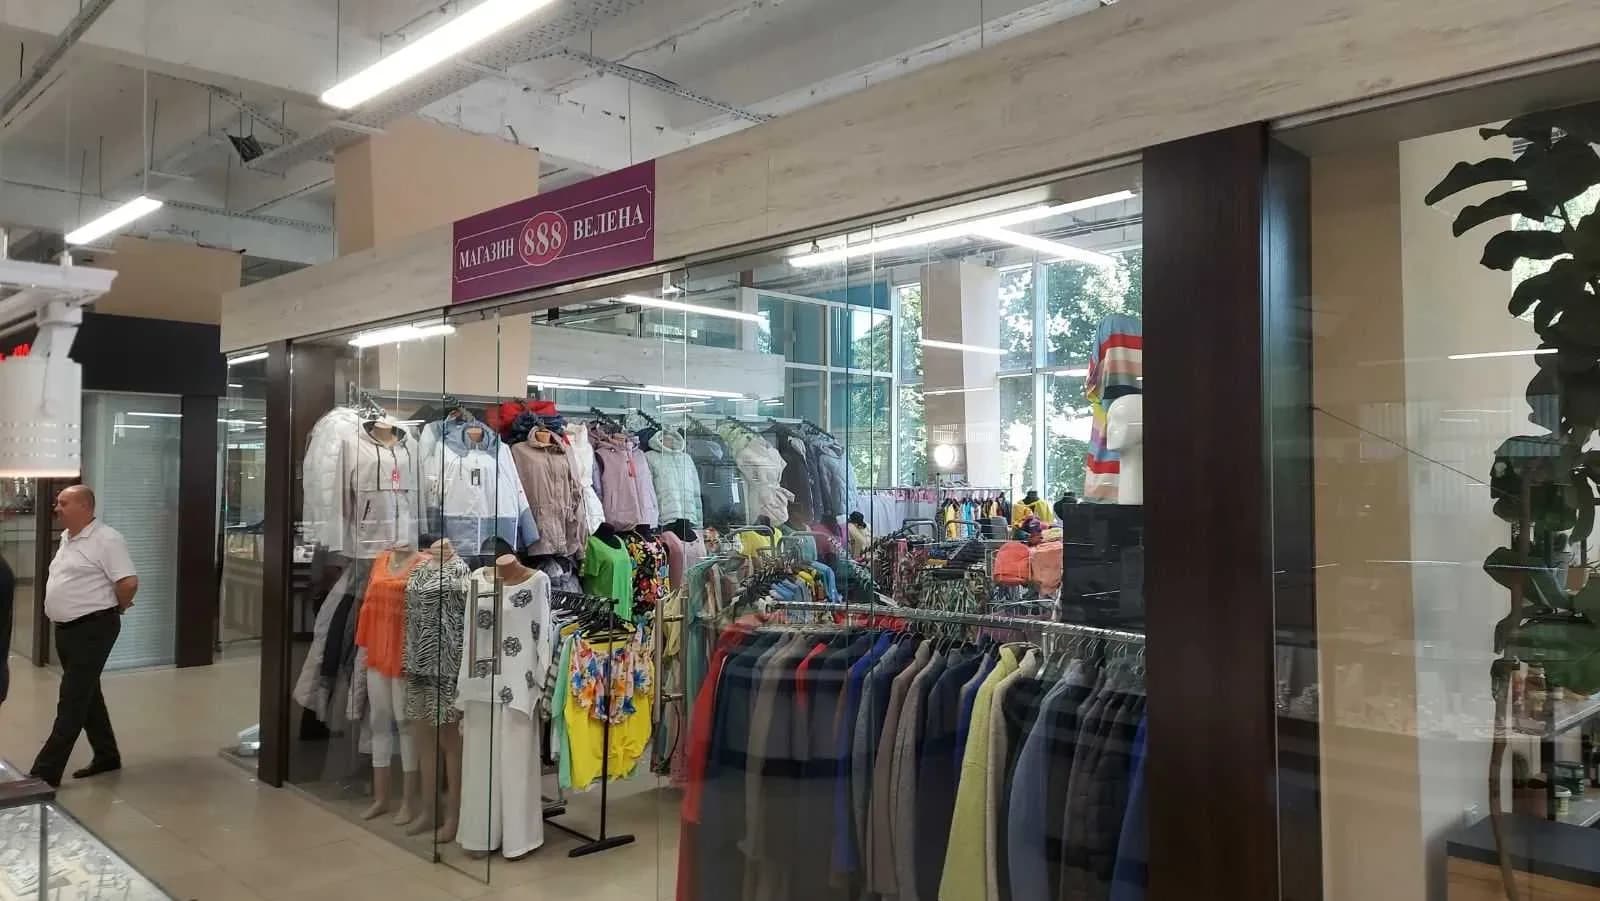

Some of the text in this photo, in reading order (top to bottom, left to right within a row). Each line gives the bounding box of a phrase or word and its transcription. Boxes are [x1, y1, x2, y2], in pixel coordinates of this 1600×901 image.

[459, 203, 644, 270] МАГАЗИН 888 ВЕЛЕНА
